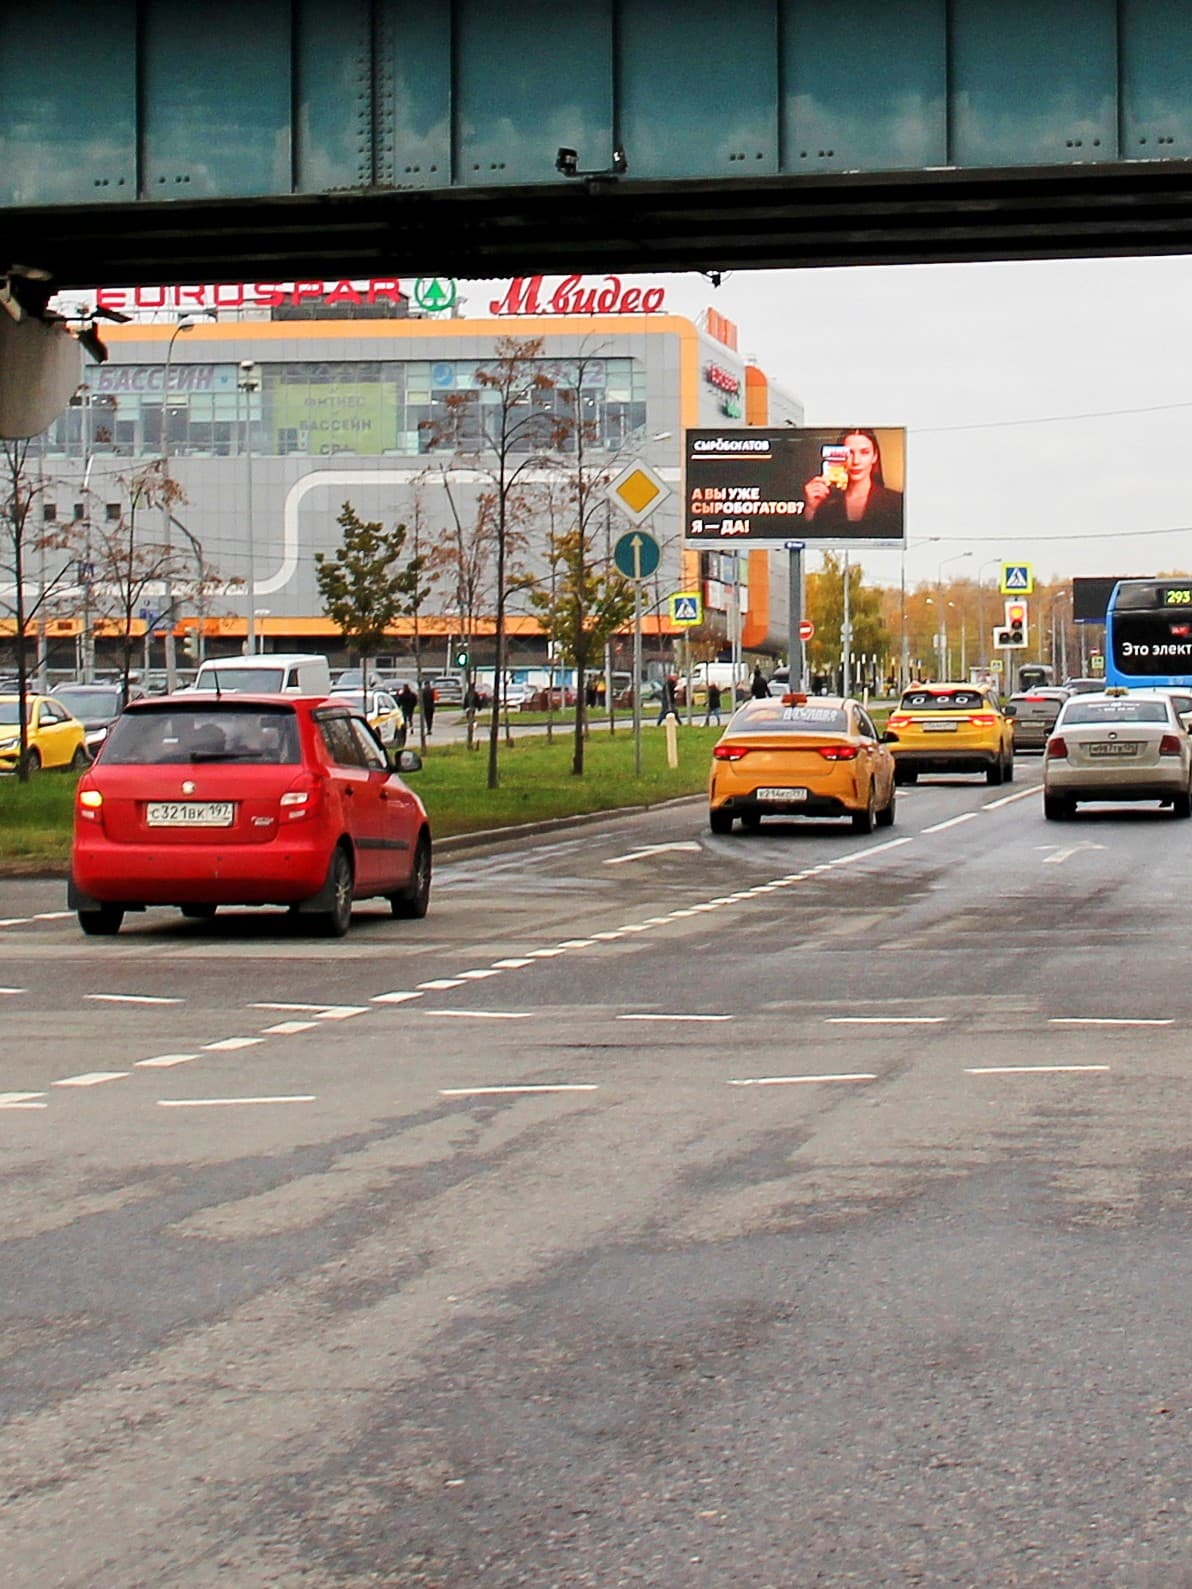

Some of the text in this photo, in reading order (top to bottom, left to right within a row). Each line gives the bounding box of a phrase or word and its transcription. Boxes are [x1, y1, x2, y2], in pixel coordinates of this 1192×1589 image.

[96, 279, 402, 309] EUROSPAR
[692, 487, 760, 500] А ВЫ УЖЕ
[691, 501, 805, 515] СЫРОБОГАТОВ?
[691, 519, 703, 533] Я
[720, 519, 750, 536] ДА!
[1167, 590, 1191, 604] 293
[1122, 641, 1149, 656] Это
